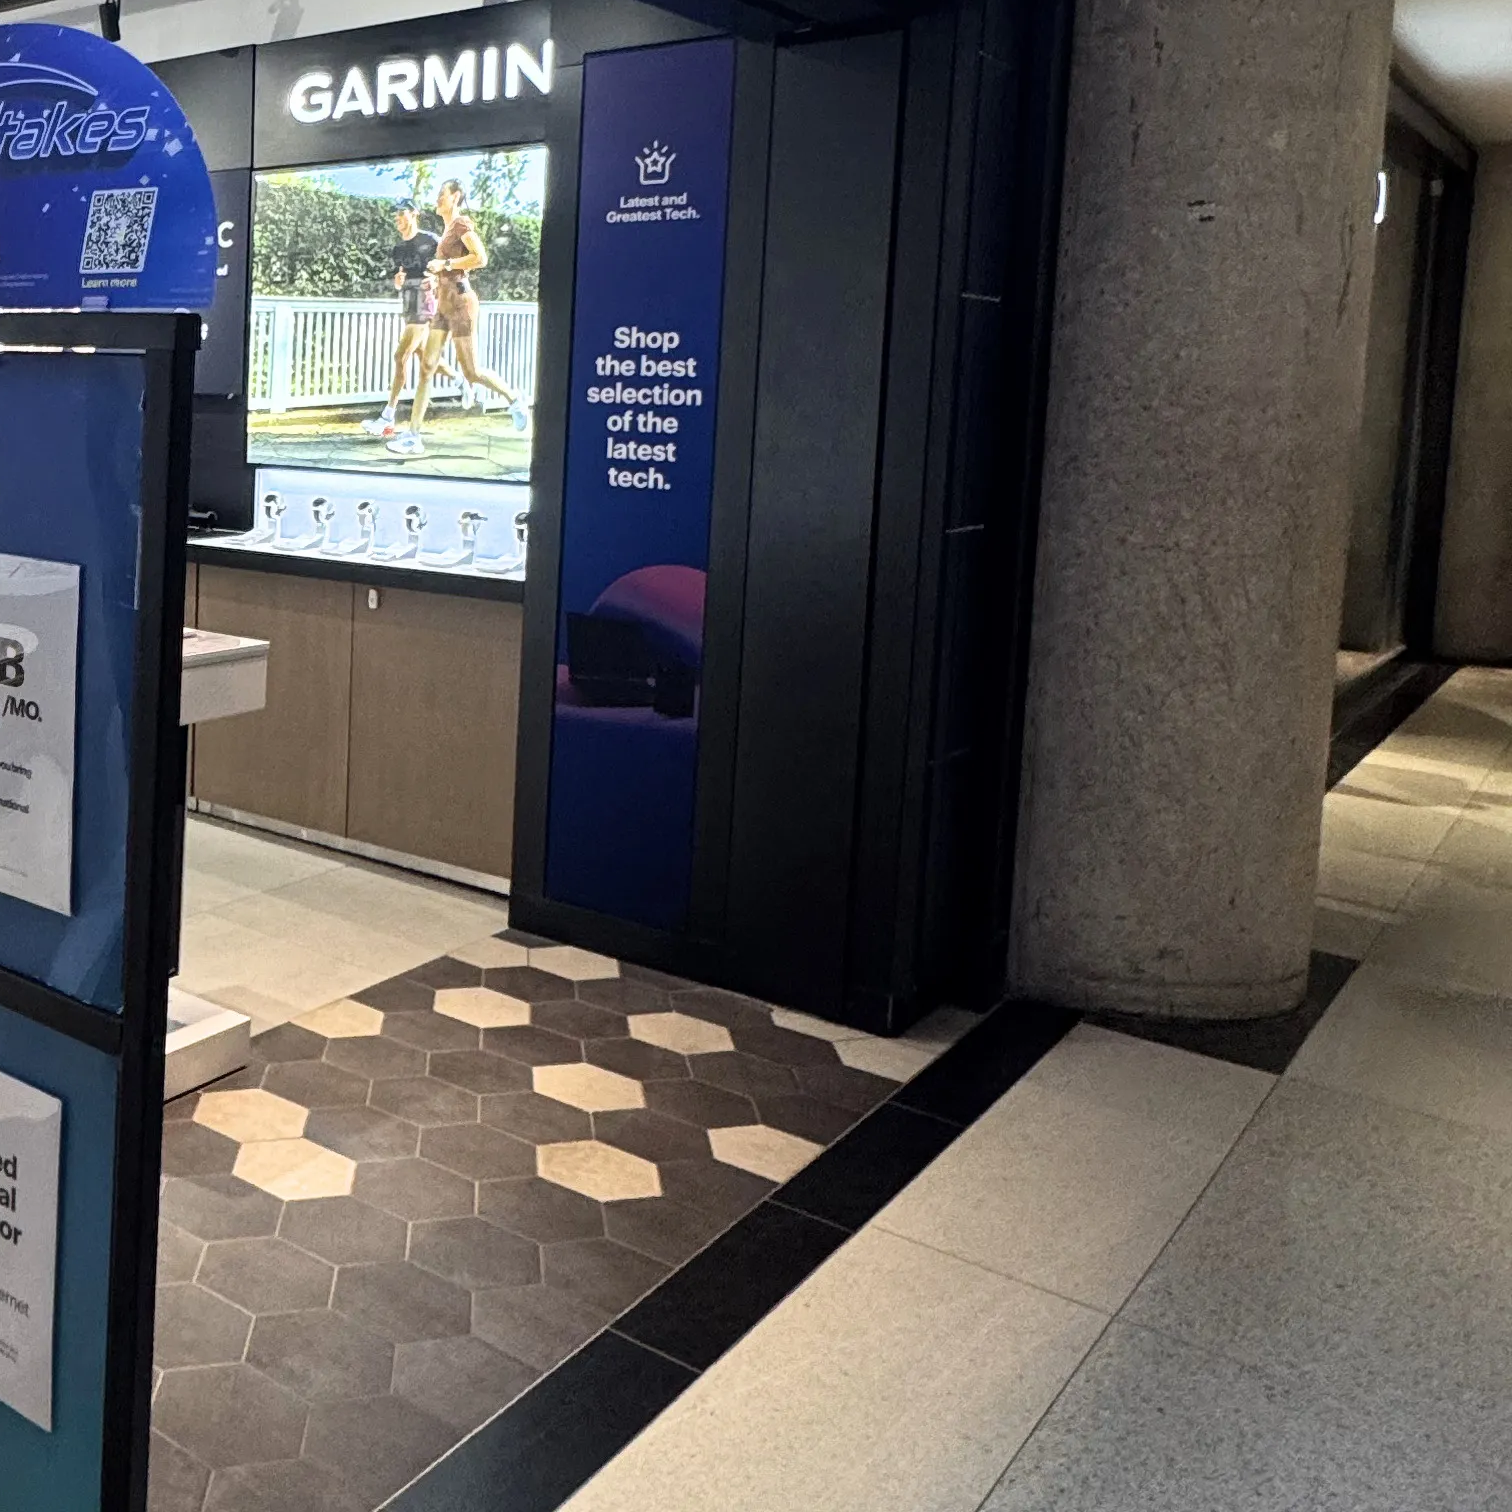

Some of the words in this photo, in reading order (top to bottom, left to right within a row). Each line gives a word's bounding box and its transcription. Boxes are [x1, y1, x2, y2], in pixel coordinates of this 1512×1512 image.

[287, 39, 555, 124] GARMIN
[619, 195, 660, 208] Latest
[661, 192, 687, 205] and
[606, 209, 662, 224] Greatest
[664, 207, 701, 221] Tech.
[614, 326, 680, 354] Shop
[595, 354, 636, 377] the
[640, 354, 697, 377] best
[587, 382, 703, 406] selection
[606, 410, 634, 432] of
[637, 410, 679, 434] the
[606, 437, 677, 463] latest
[607, 467, 672, 490] tech.
